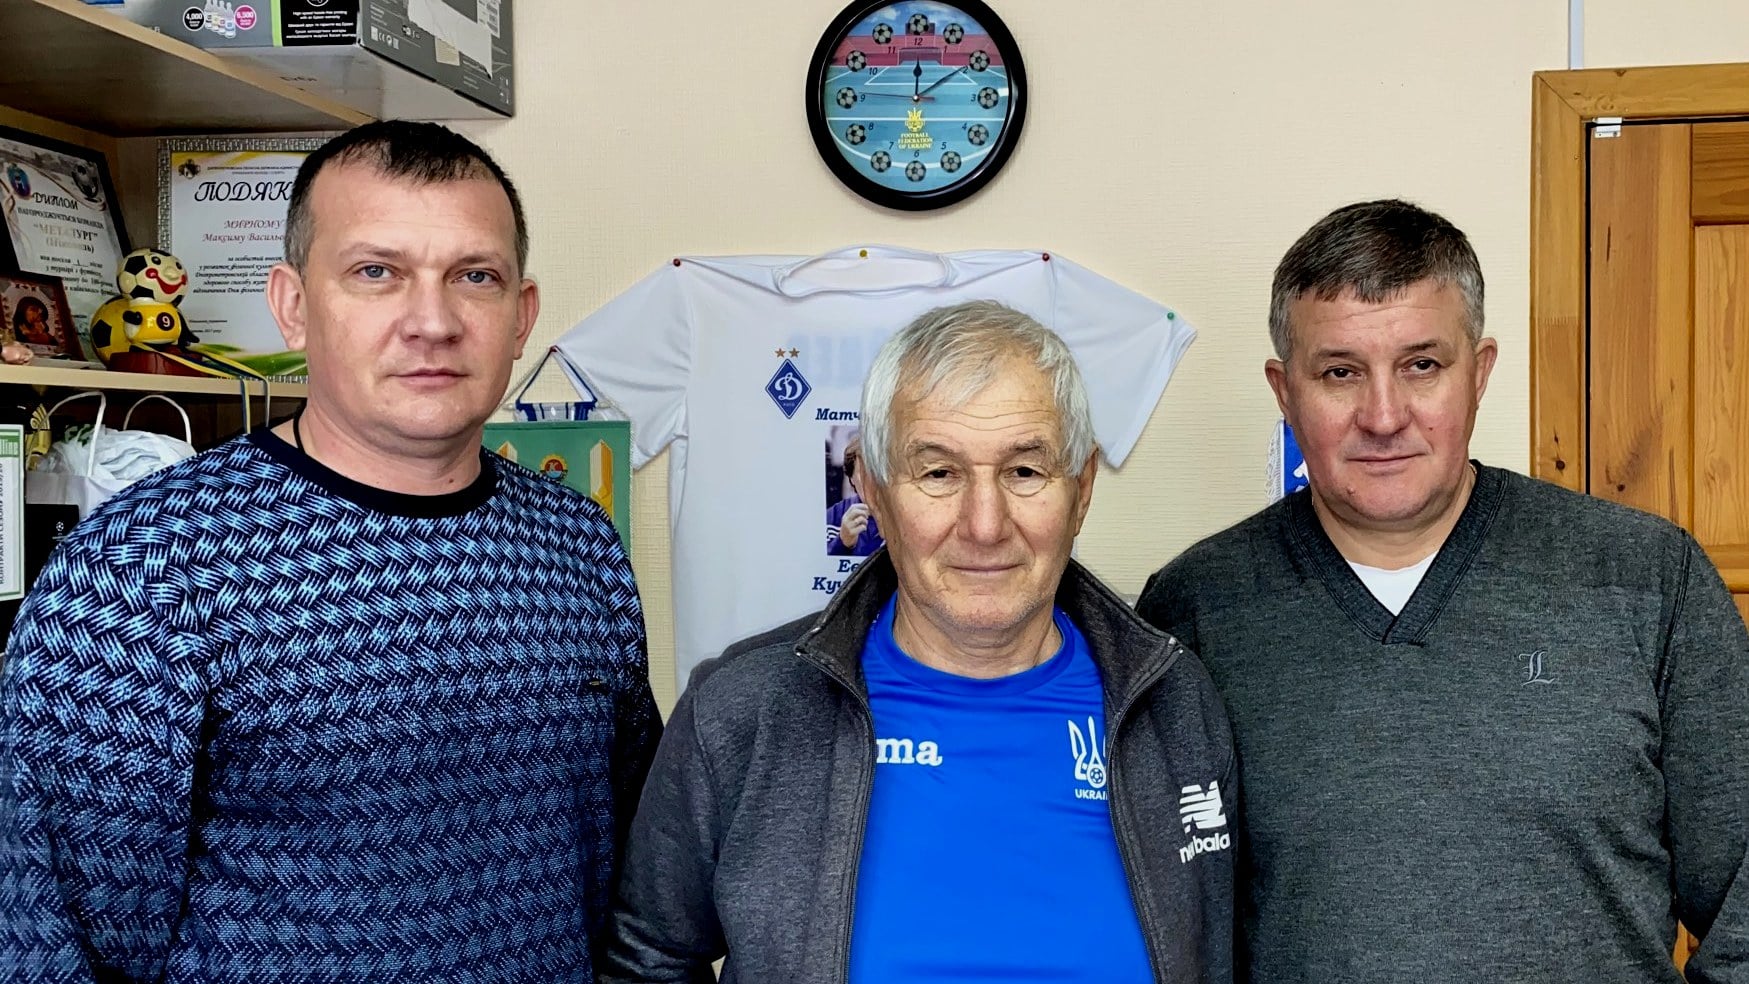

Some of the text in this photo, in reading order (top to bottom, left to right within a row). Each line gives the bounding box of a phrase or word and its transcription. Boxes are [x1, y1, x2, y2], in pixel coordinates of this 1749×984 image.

[914, 37, 923, 46] 12
[887, 46, 896, 54] 11
[943, 45, 948, 53] 1
[869, 67, 878, 76] 10
[962, 65, 969, 74] 2
[860, 94, 866, 102] 9
[970, 94, 977, 102] 3
[868, 123, 874, 131] 8
[962, 123, 968, 131] 4
[889, 141, 895, 150] 7
[940, 141, 947, 150] 5
[913, 150, 920, 158] 6
[32, 192, 79, 210] ДИПЛОМ
[162, 315, 170, 328] 9
[876, 738, 943, 767] ma
